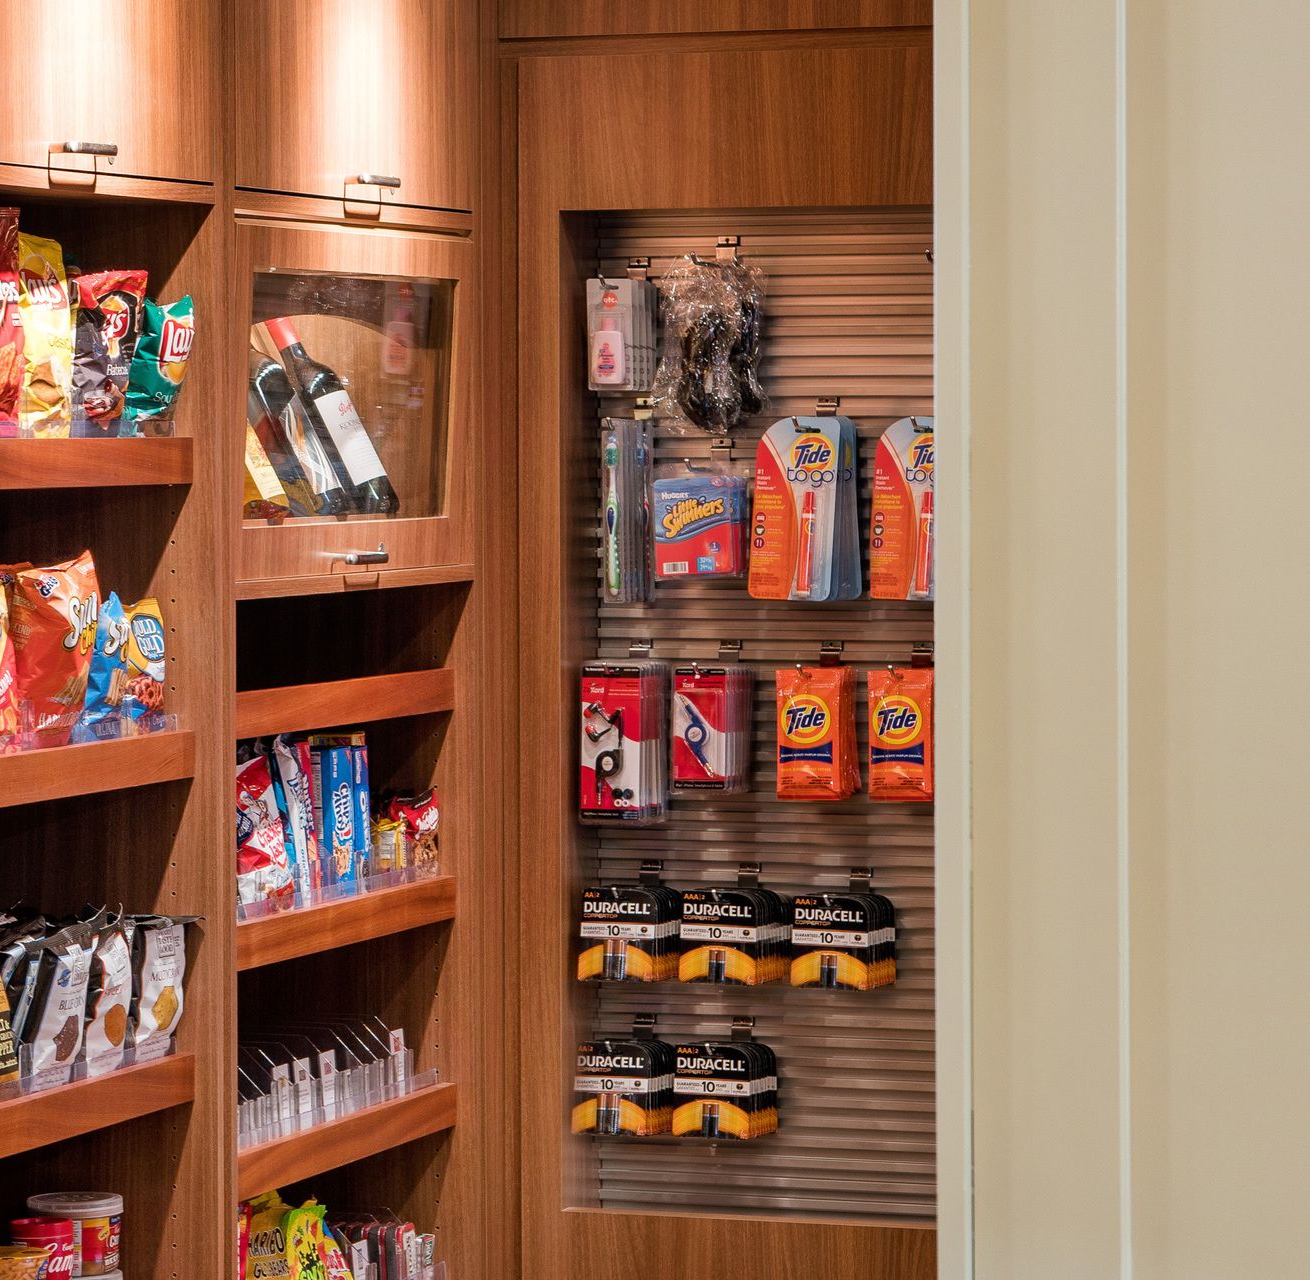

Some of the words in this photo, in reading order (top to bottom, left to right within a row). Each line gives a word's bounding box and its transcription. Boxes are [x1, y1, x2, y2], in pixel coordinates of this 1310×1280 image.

[795, 443, 832, 468] Tide
[786, 467, 808, 482] to
[810, 470, 834, 488] go
[905, 466, 927, 482] to
[662, 497, 725, 539] Swimmers
[137, 633, 165, 657] GOLD
[786, 706, 826, 735] Tide
[877, 706, 918, 736] Tide
[584, 901, 651, 915] DURACELL
[683, 903, 752, 917] DURACELL
[795, 908, 864, 923] DURACELL
[607, 925, 620, 936] 10
[708, 927, 722, 938] 10
[820, 932, 834, 943] 10
[577, 1055, 644, 1069] DURACELL
[677, 1056, 745, 1072] DURACELL
[600, 1079, 614, 1090] 10
[702, 1081, 715, 1093] 10
